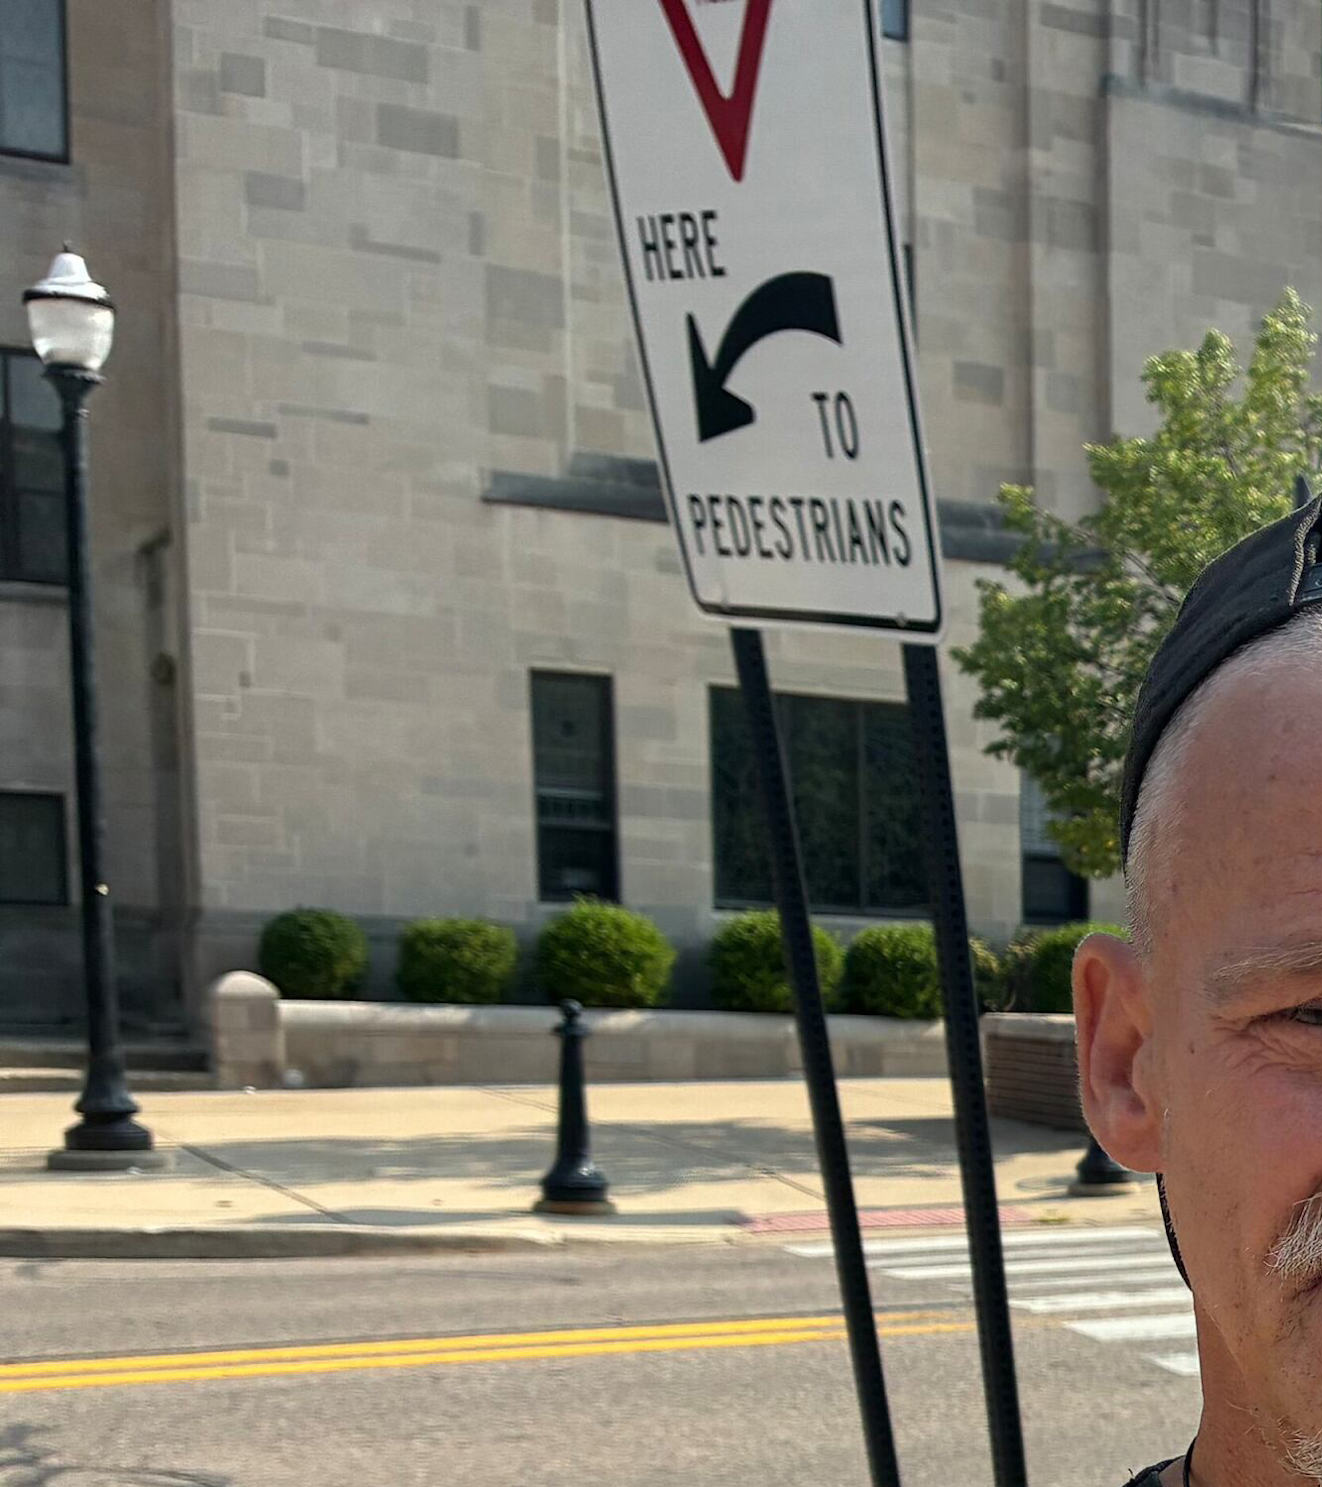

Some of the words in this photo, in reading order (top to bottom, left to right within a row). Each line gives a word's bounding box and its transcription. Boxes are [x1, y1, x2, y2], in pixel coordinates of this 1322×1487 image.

[637, 210, 728, 282] HERE
[811, 392, 859, 460] TO
[686, 494, 912, 568] PEDESTRIANS
